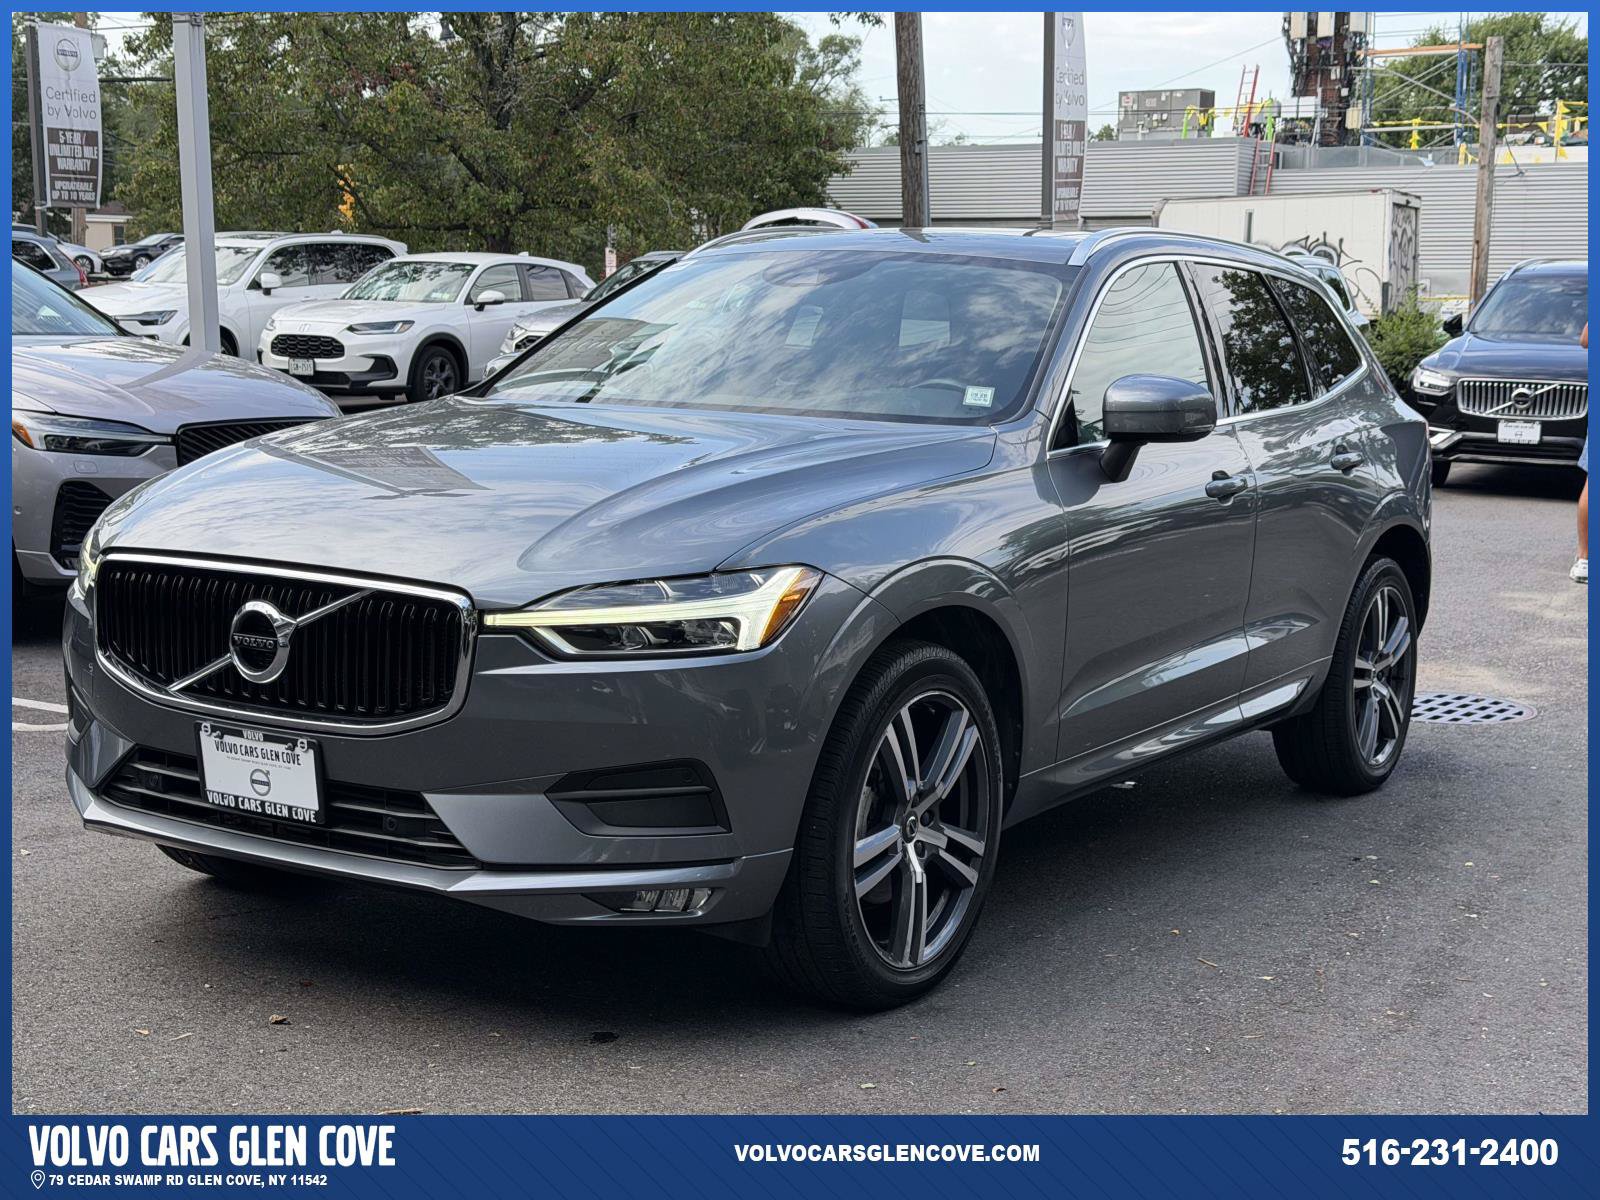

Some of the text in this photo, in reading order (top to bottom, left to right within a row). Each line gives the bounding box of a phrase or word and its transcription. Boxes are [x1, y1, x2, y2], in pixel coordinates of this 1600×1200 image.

[46, 87, 96, 103] Certified
[47, 102, 97, 119] by Volvo
[49, 143, 98, 159] UNLIMITED MILE
[57, 157, 91, 171] WARRANTY
[233, 635, 274, 649] VOLVO
[242, 729, 264, 741] VOLVO
[214, 740, 239, 755] VOLVO
[240, 744, 260, 759] CARS
[260, 748, 280, 763] GLEN
[281, 751, 302, 766] COVE
[207, 791, 316, 823] VOLVO CARS GLEN COVE
